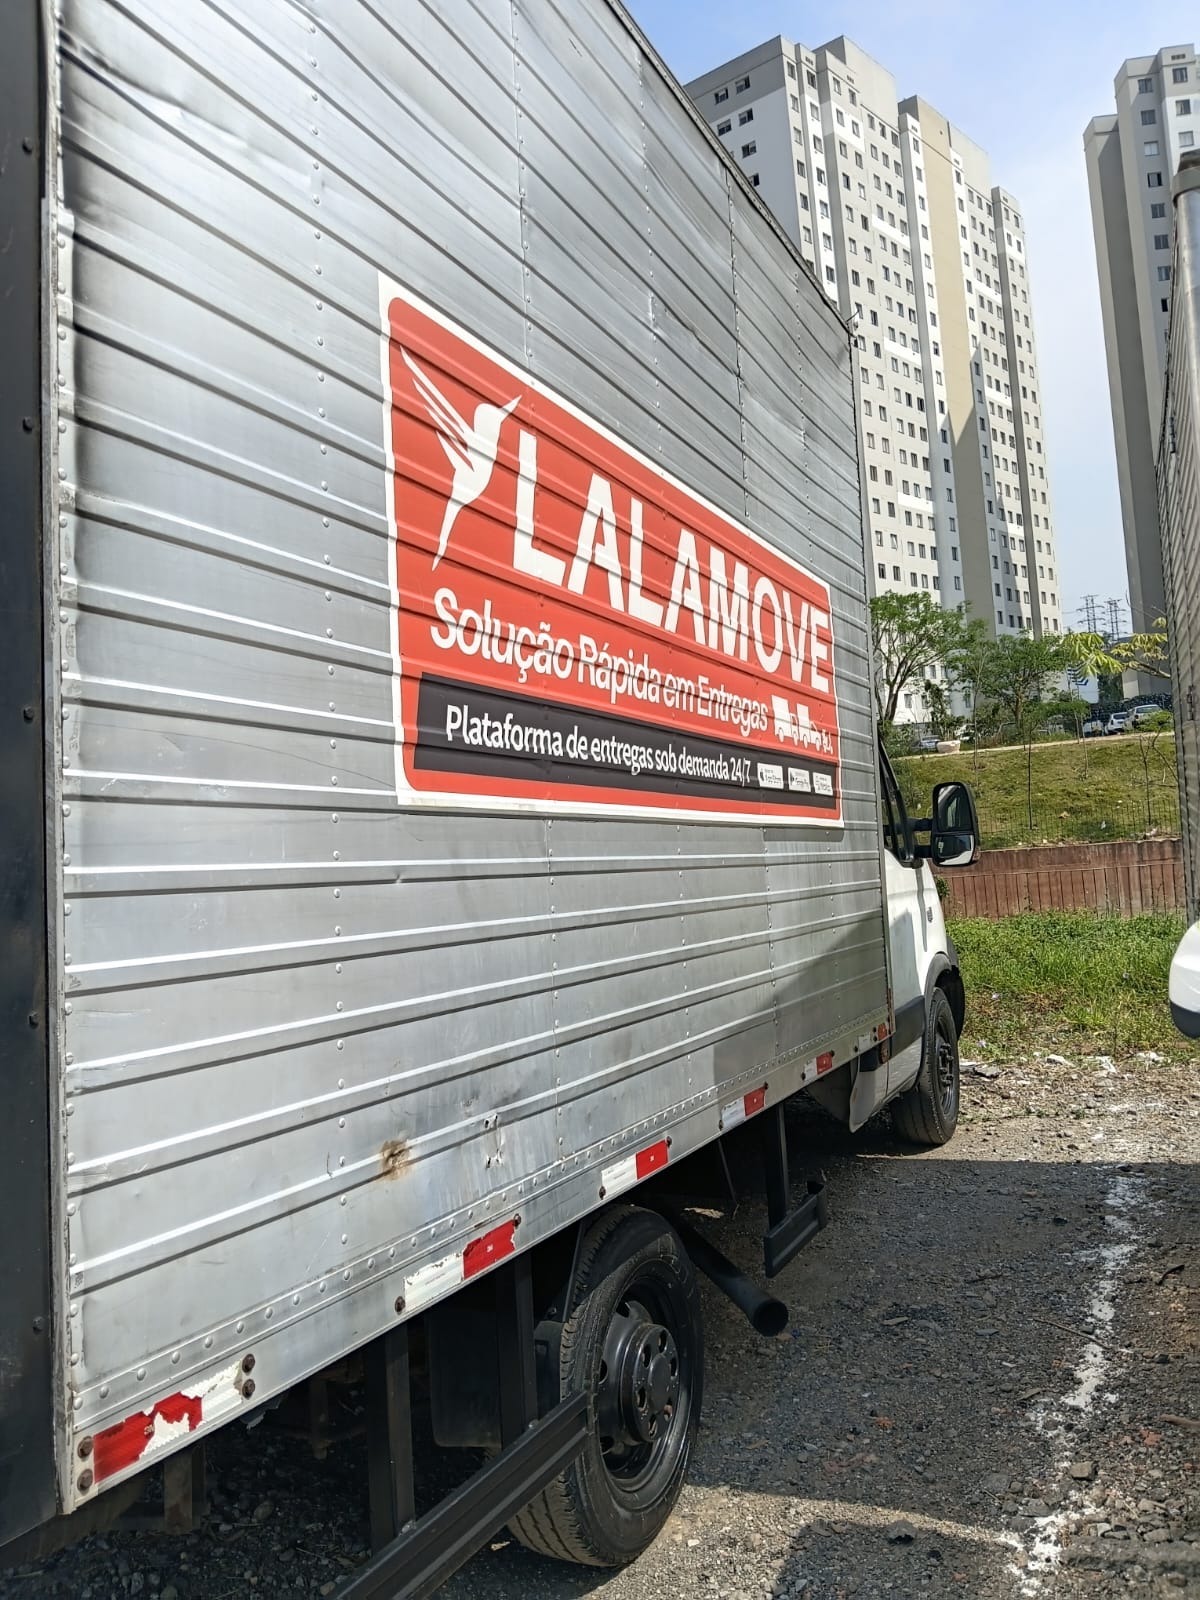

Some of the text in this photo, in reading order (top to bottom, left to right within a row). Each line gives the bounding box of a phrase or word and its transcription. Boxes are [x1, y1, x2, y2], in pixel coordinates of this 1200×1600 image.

[512, 428, 830, 694] LALAMOVE
[430, 587, 768, 737] Solução Rápida em Entregas
[446, 704, 564, 757] Plataforma
[565, 725, 589, 760] de
[590, 735, 654, 775] entregas
[655, 744, 677, 774] sob
[678, 747, 730, 780] demanda
[730, 757, 751, 787] 24/7
